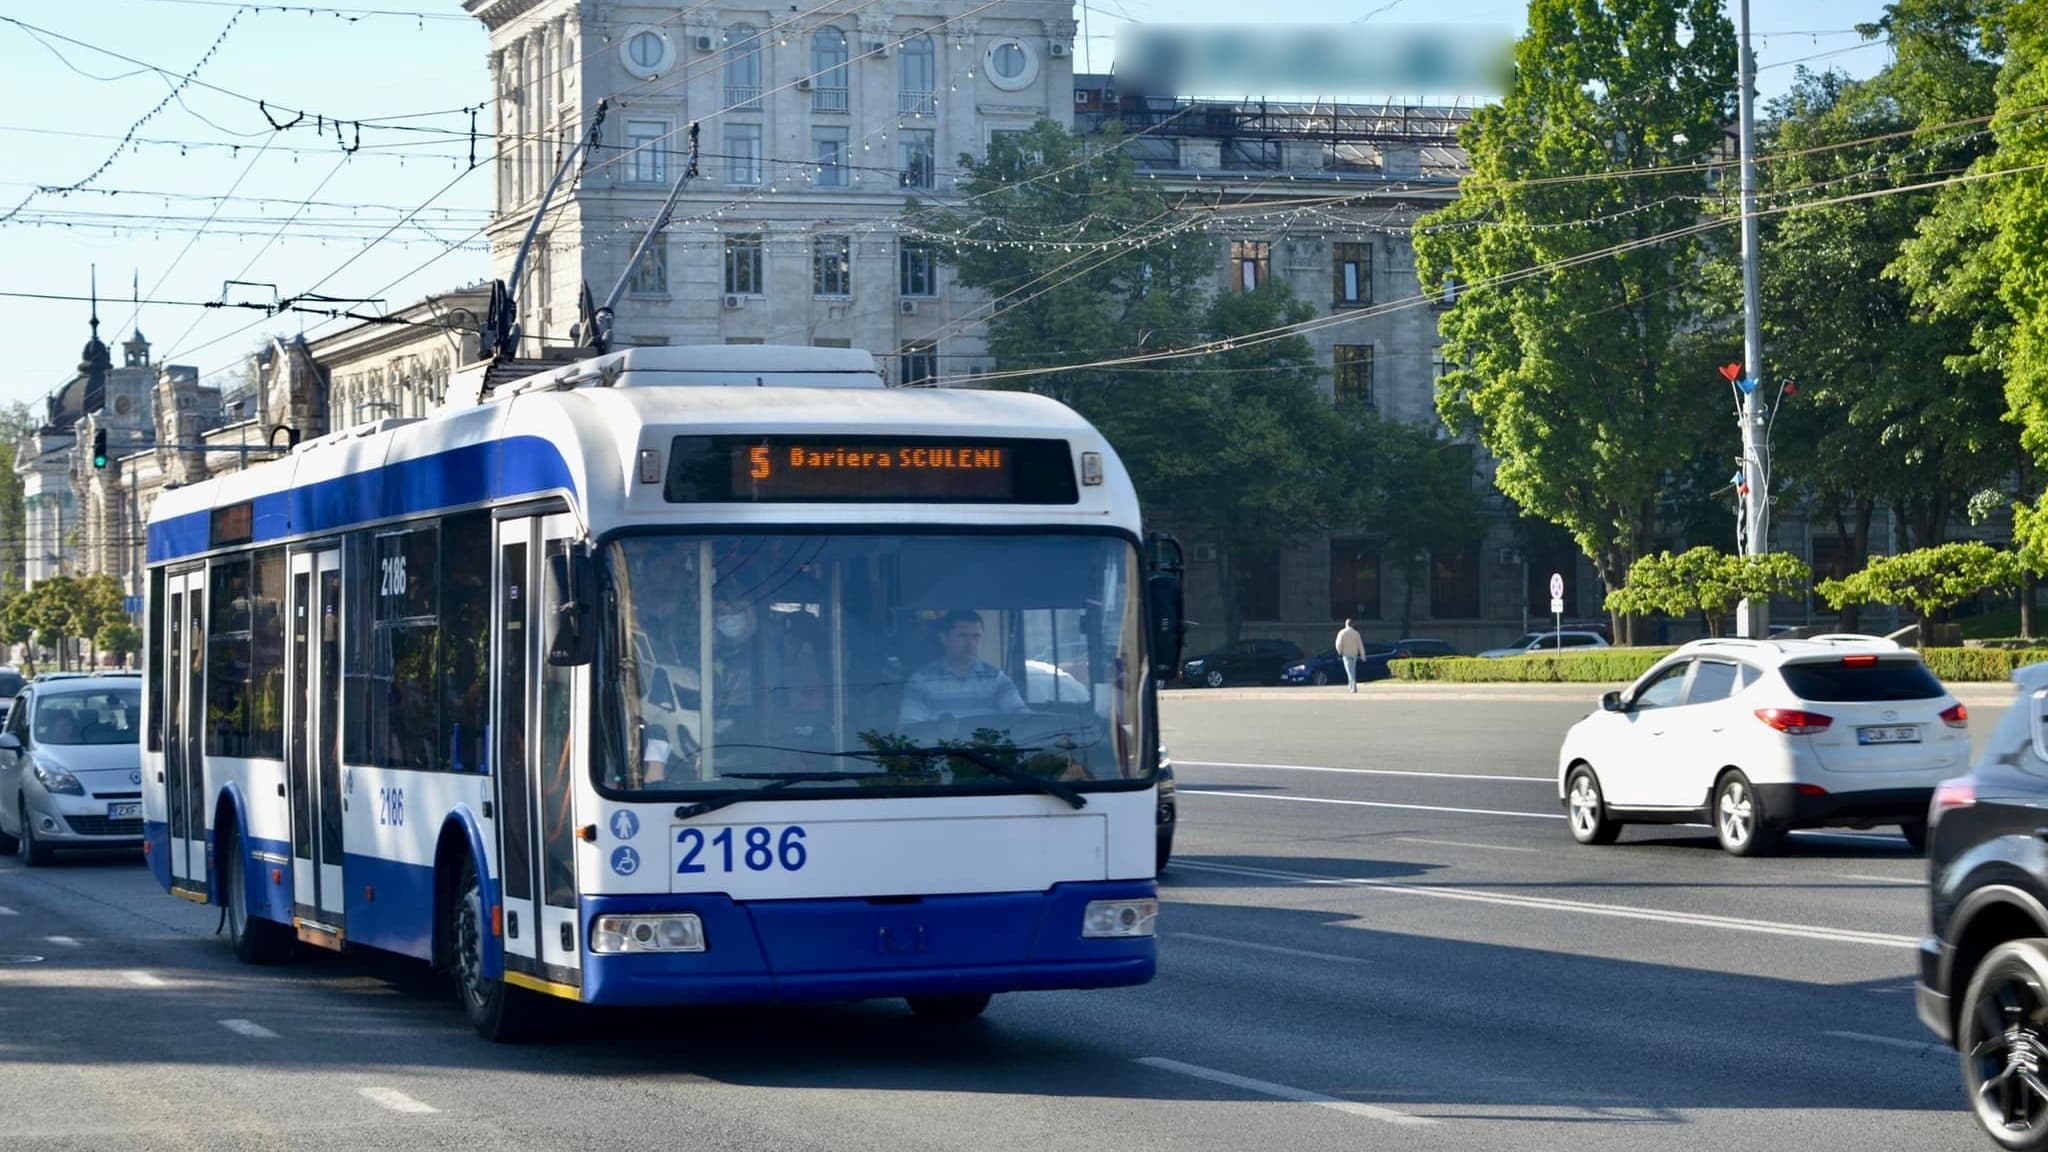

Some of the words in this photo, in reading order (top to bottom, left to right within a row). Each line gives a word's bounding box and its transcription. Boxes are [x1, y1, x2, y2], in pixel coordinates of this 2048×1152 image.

[751, 446, 769, 478] 5
[790, 447, 891, 467] Bariera
[899, 448, 1001, 468] SCULENI
[381, 555, 407, 597] 2186
[379, 787, 404, 827] 2186
[676, 825, 807, 874] 2186
